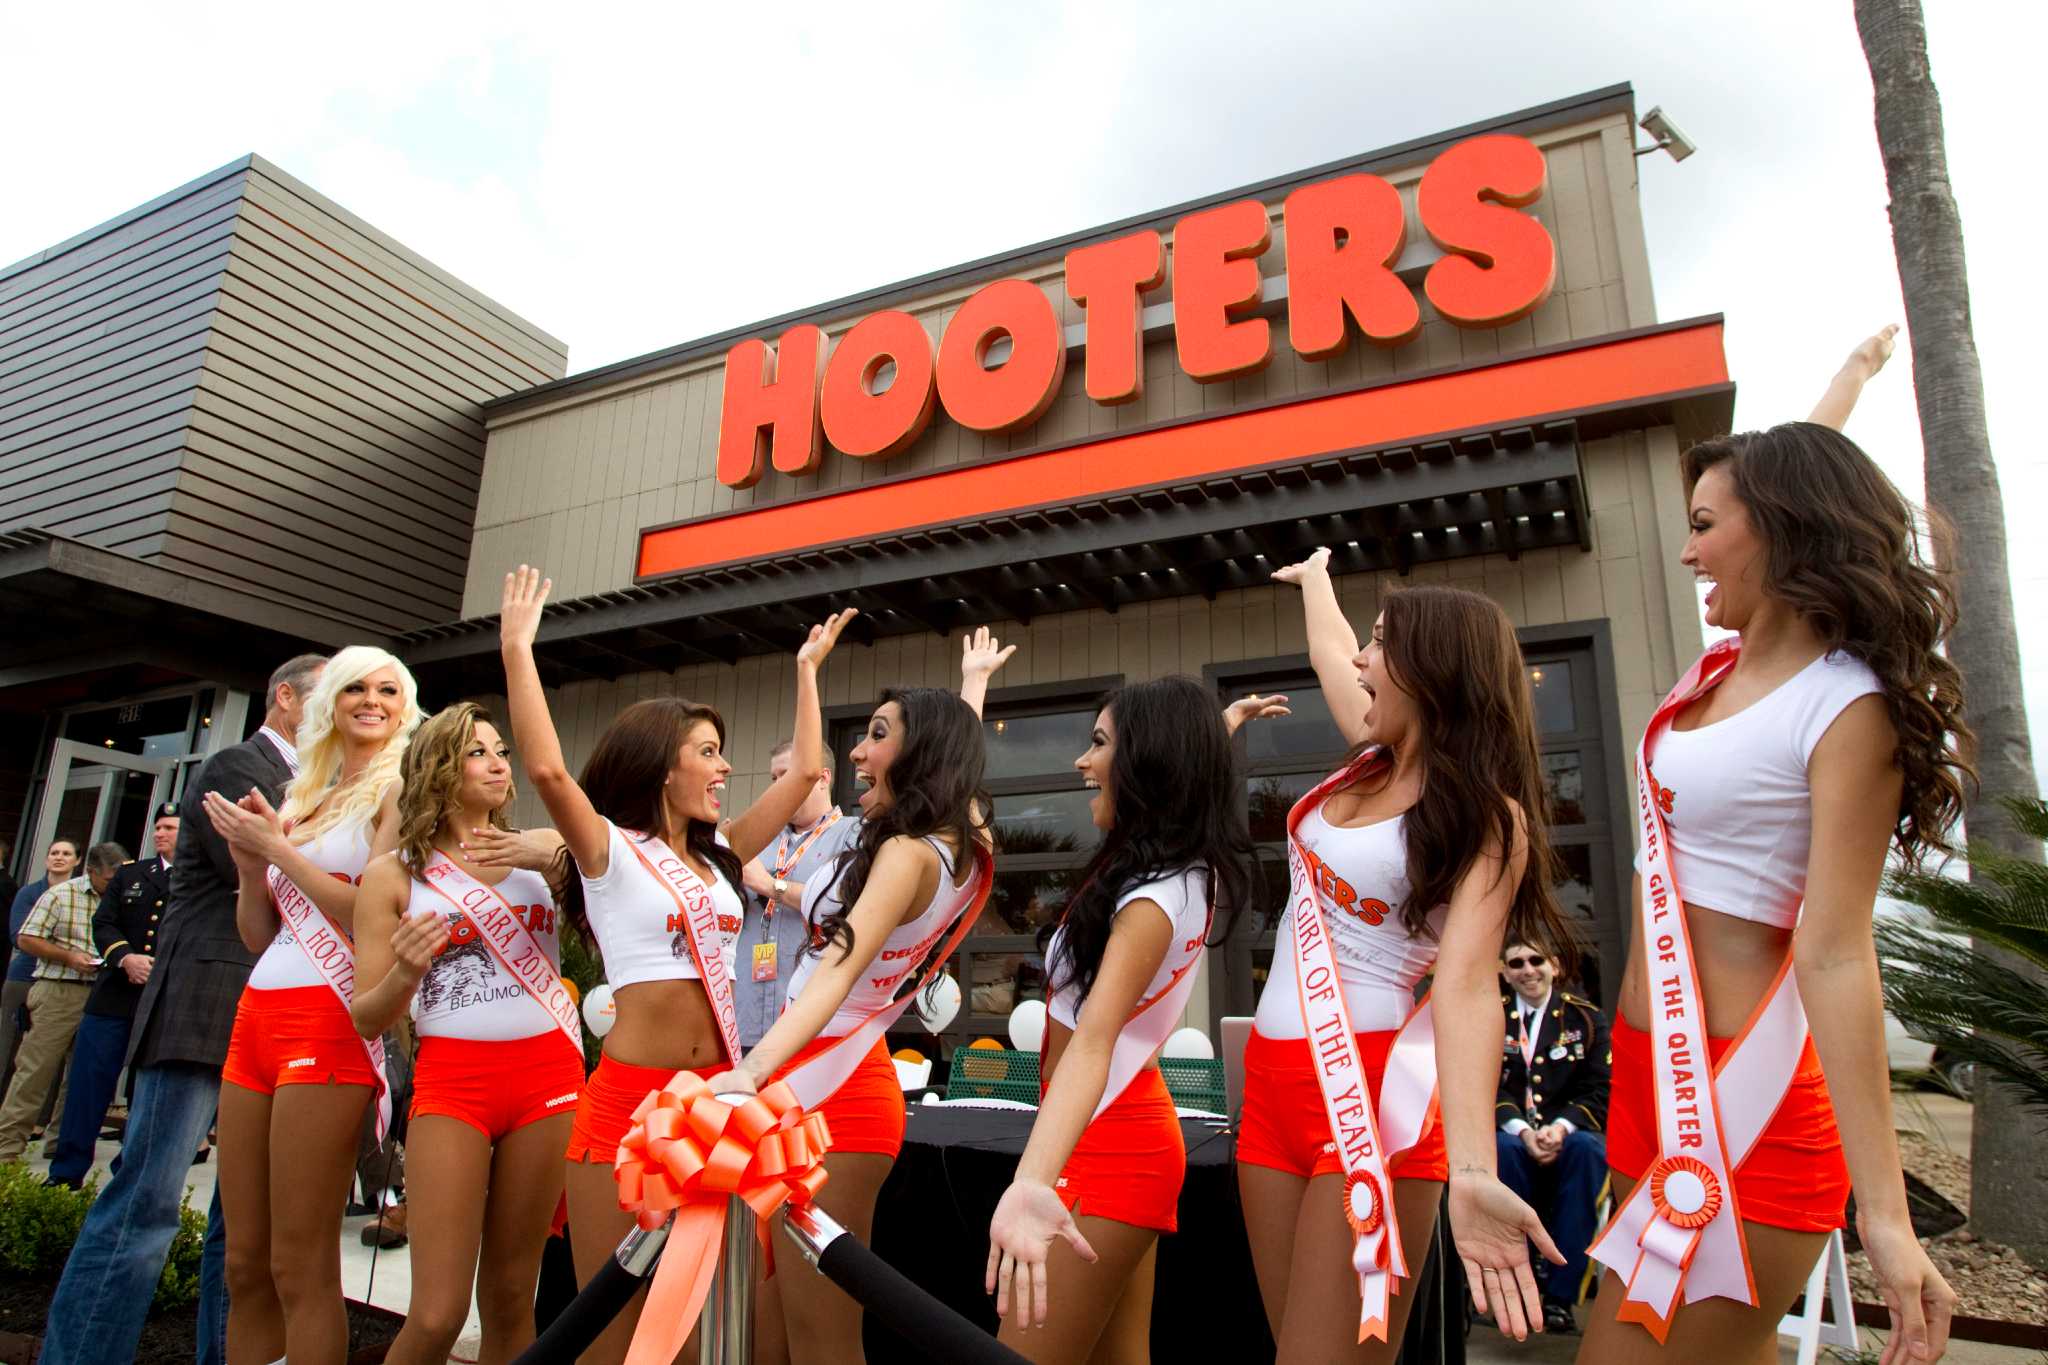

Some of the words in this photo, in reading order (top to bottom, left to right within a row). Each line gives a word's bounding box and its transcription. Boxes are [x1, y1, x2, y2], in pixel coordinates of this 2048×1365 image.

[717, 133, 1557, 491] HOOTERS
[1297, 897, 1323, 962] GIRL
[1650, 873, 1669, 924] GIRL
[306, 927, 354, 1004] HOOTE
[462, 888, 520, 955] CLARA,
[512, 946, 553, 993] 2013
[1656, 934, 1677, 963] OF
[450, 983, 530, 1010] BEAUMON
[703, 947, 729, 1002] 2013
[1306, 966, 1336, 1003] OF
[1662, 974, 1685, 1021] THE
[1315, 1012, 1353, 1078] THE
[1667, 1031, 1703, 1149] QUARTER
[1333, 1082, 1373, 1170] YEAR
